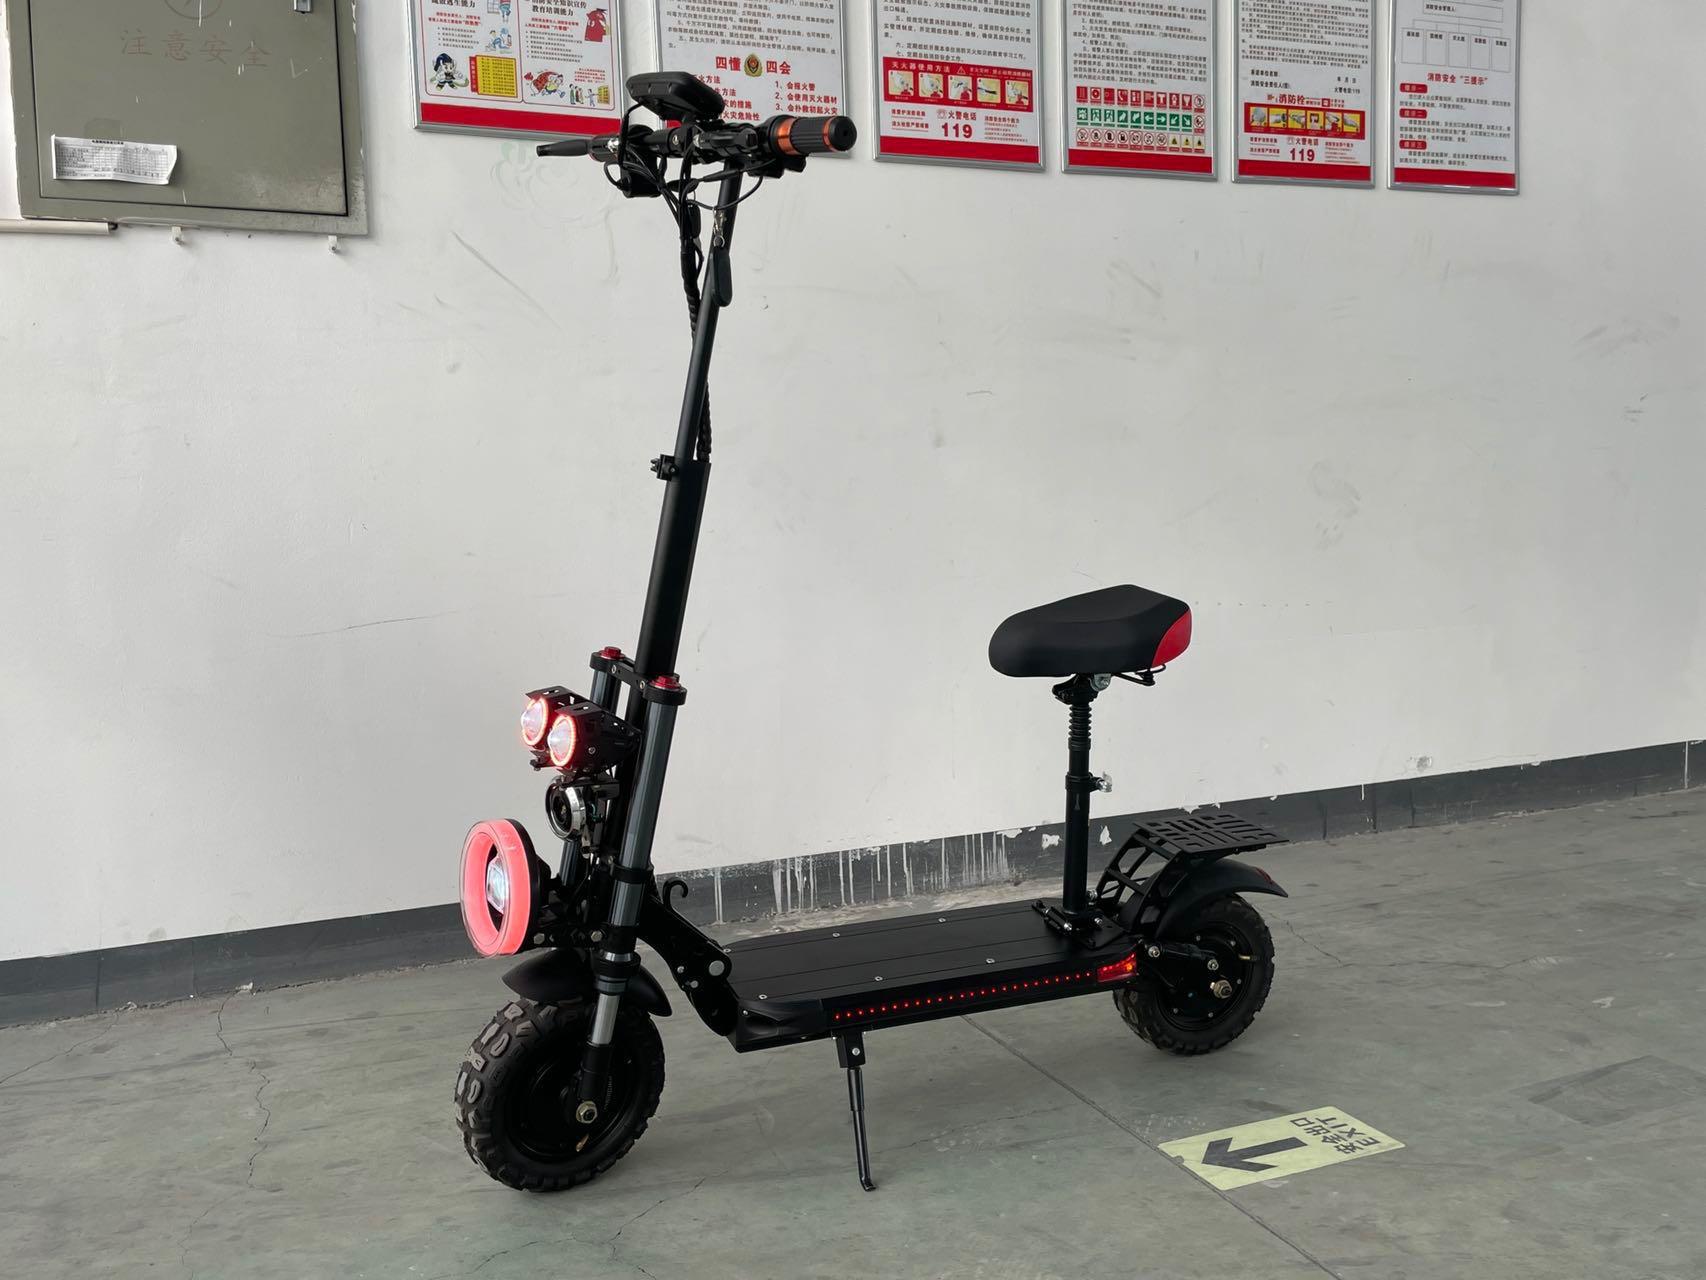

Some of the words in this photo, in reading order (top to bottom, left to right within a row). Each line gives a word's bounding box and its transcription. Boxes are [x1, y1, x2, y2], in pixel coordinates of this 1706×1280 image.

[120, 28, 273, 67] 注意安全
[716, 56, 741, 72] 四懂
[766, 60, 791, 75] 四会
[892, 61, 950, 73] 灭火器使用方法
[775, 92, 837, 104] 2、会使用灭火器材
[1279, 94, 1305, 105] 消防栓
[948, 110, 977, 121] 火警电话
[941, 122, 973, 139] 119
[1290, 148, 1315, 162] 119
[1290, 1116, 1364, 1155] 安全出口
[1315, 1117, 1380, 1146] EXIT
